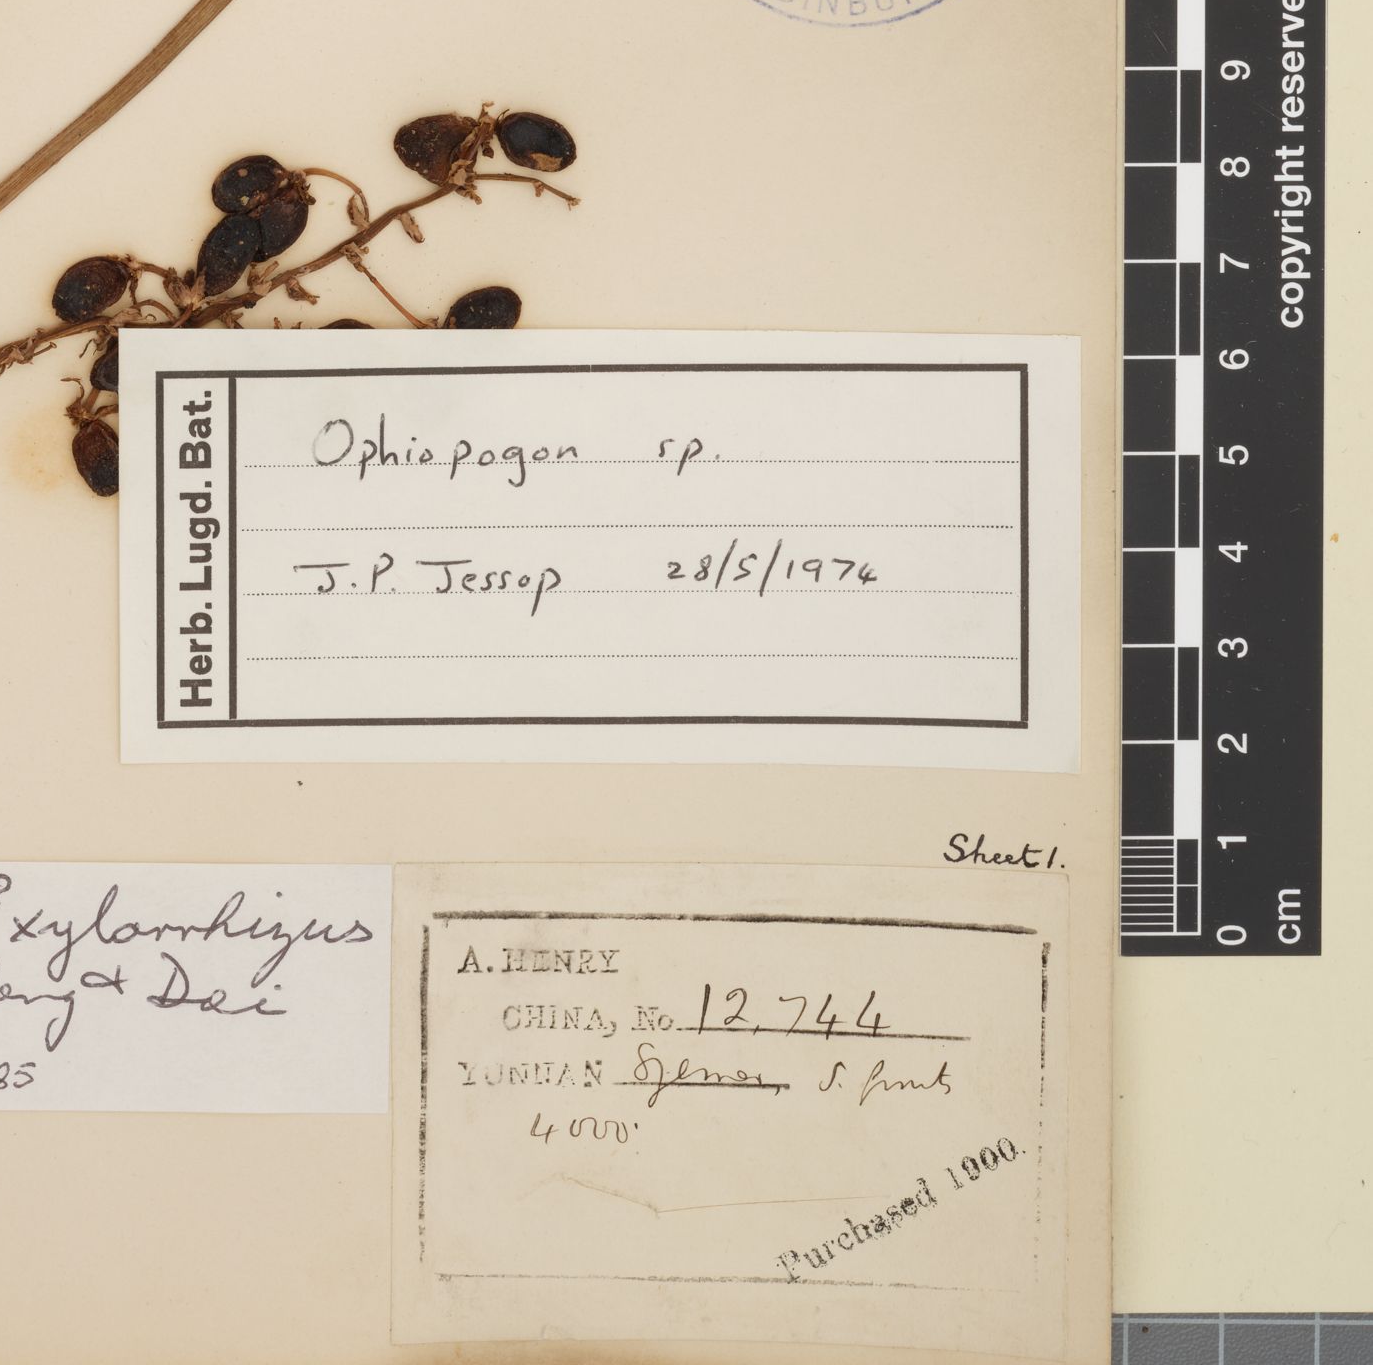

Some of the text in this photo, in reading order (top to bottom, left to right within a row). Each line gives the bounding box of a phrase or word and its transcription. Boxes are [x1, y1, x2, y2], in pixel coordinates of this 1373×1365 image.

[1219, 59, 1251, 81] 9
[1219, 156, 1251, 178] 8
[1273, 145, 1312, 329] copyright
[1219, 252, 1250, 274] 7
[1218, 348, 1250, 370] 6
[310, 413, 723, 487] Ophiopogon sp.
[1218, 444, 1250, 466] 5
[178, 390, 221, 708] Herb. Lugd. Bat.
[1218, 541, 1249, 563] 4
[416, 558, 561, 614] Jessop
[667, 539, 879, 597] 28/5/1974
[1217, 637, 1249, 659] 3
[1216, 732, 1248, 754] 2
[1216, 835, 1247, 850] 1
[1277, 888, 1302, 945] cm
[1216, 924, 1248, 946] 0
[501, 949, 620, 973] HENRY
[502, 1005, 618, 1037] CHINA,
[458, 1062, 604, 1088] YUNNAN
[774, 1136, 1026, 1285] Purchased 1900.
